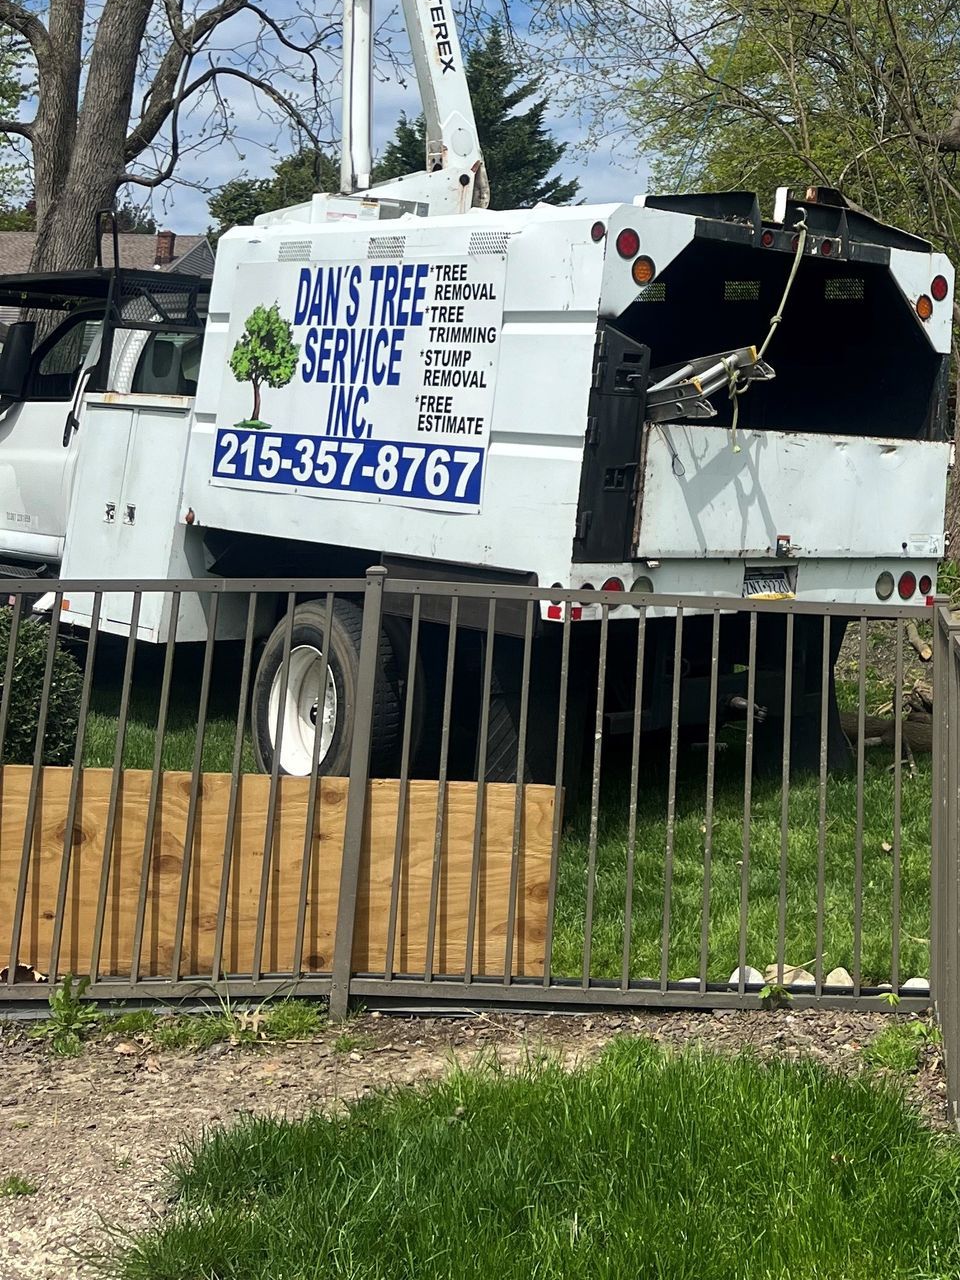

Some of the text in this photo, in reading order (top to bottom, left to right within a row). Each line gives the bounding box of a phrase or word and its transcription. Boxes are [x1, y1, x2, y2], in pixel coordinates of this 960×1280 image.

[293, 263, 430, 327] DAN'S TREE
[434, 283, 497, 301] REMOVAL
[428, 326, 497, 344] TRIMMING
[301, 327, 406, 386] SERVICE
[423, 369, 487, 389] REMOVAL
[325, 384, 374, 439] INC.
[417, 414, 484, 435] ESTIMATE
[216, 432, 481, 498] 215-357-8767
